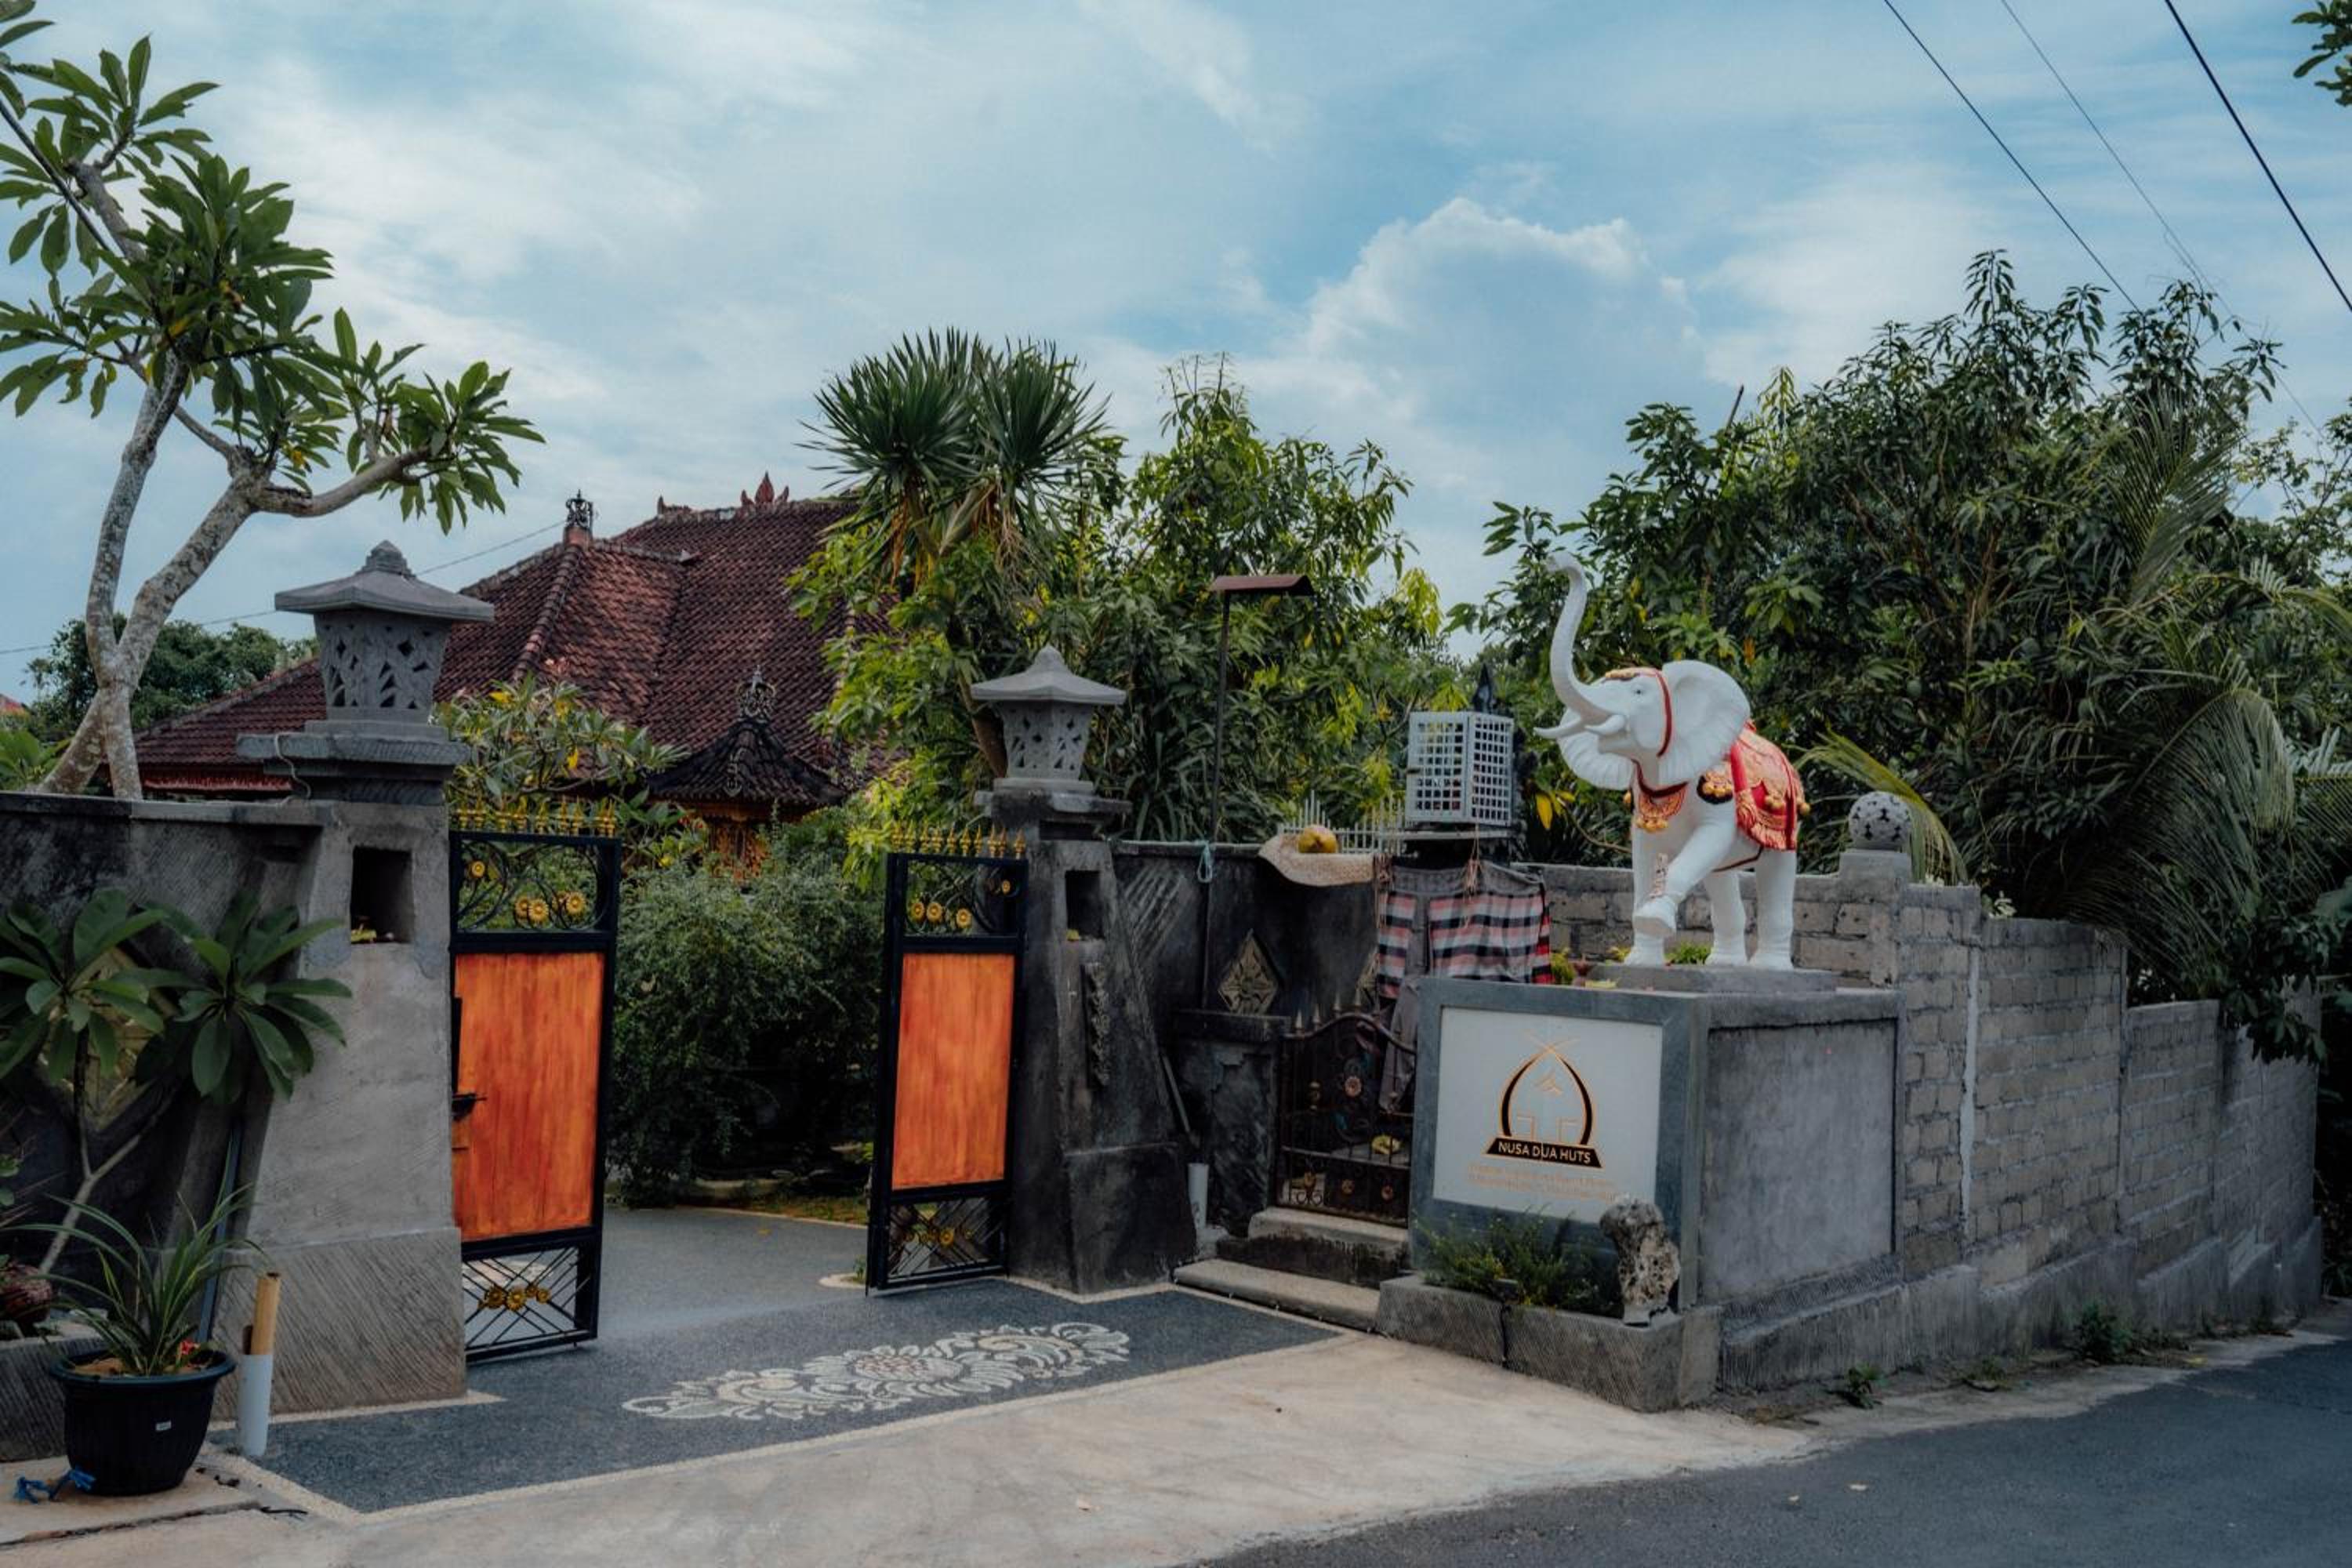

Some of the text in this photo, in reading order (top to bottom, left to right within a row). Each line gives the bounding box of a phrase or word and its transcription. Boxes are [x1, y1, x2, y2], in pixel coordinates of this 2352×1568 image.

[1497, 1141, 1592, 1164] NUSA DUA HUTS
